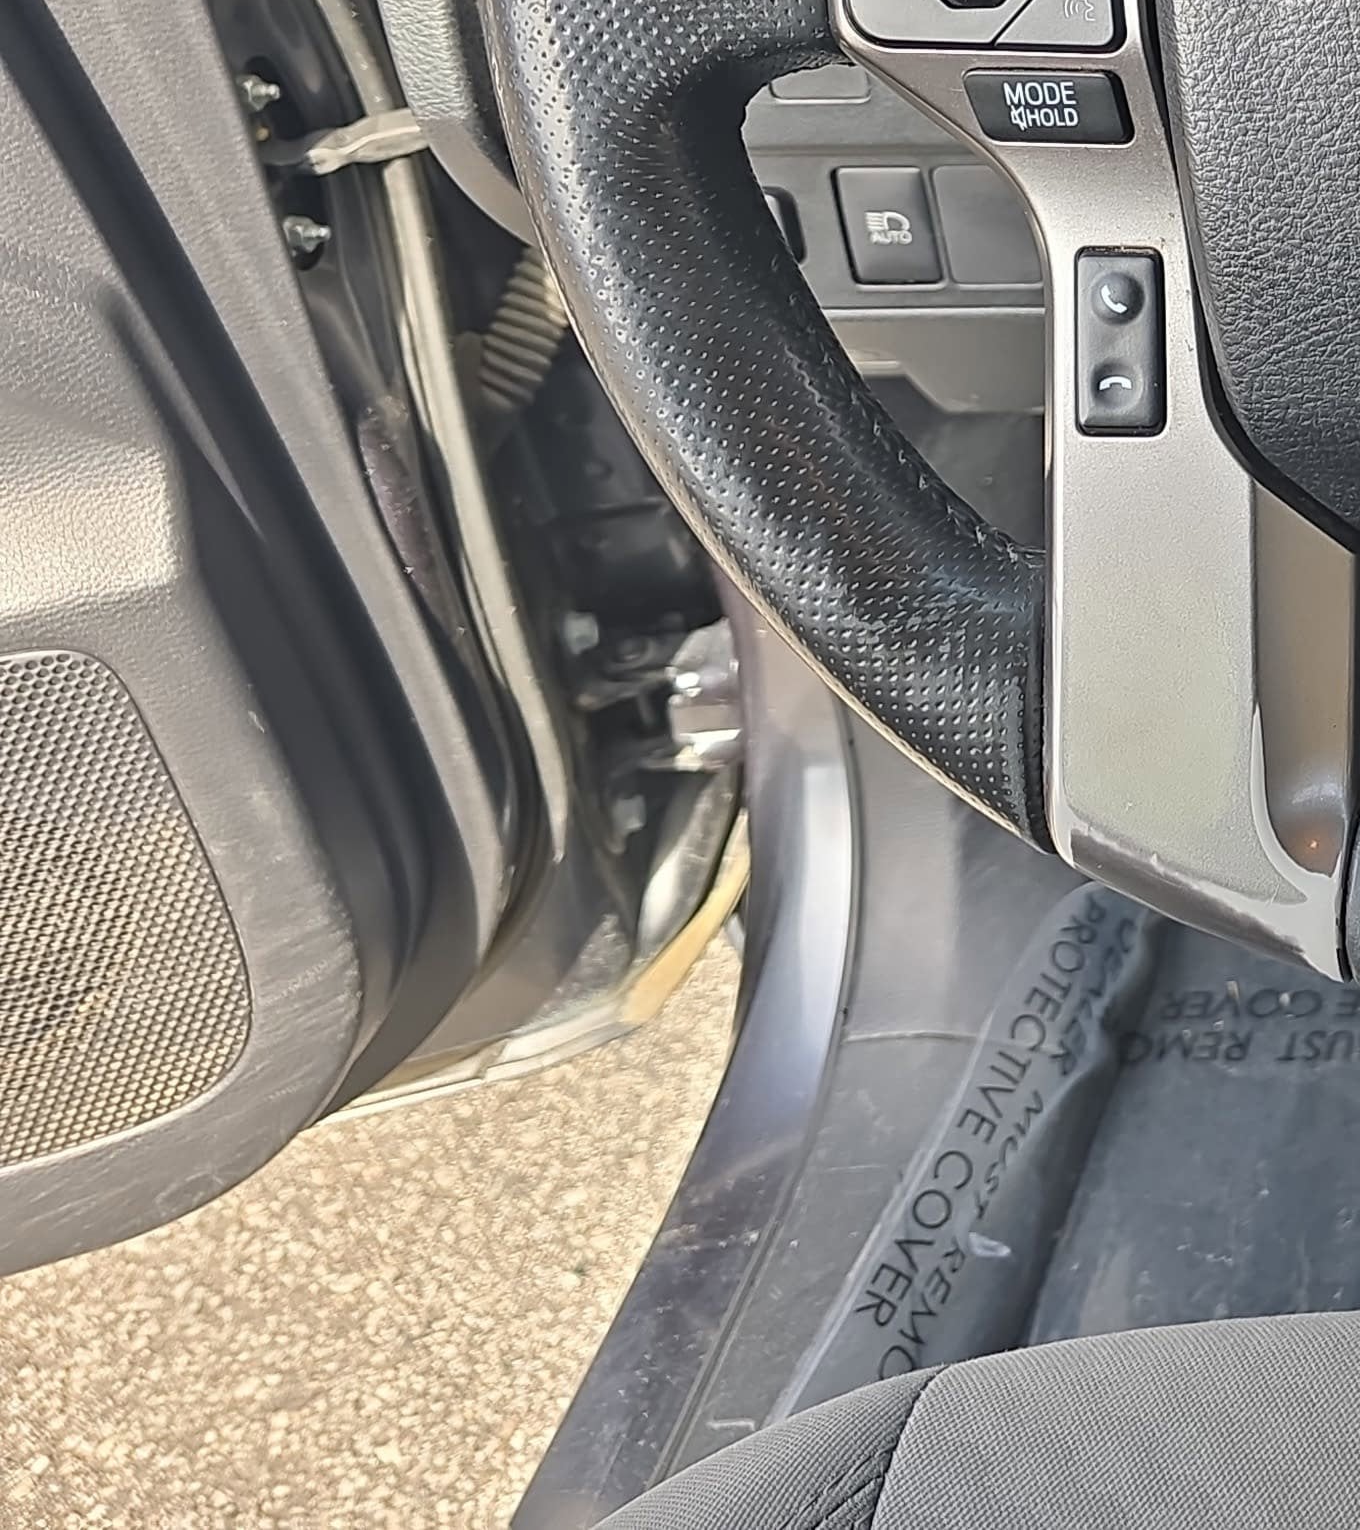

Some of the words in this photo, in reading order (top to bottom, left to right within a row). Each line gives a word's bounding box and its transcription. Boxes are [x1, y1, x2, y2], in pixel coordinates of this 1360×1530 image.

[1003, 82, 1076, 107] MODE
[1027, 107, 1078, 129] HOLD
[871, 230, 912, 245] AUTO
[957, 896, 1108, 1144] PROTECTIVE
[1163, 989, 1322, 1021] COVER
[972, 1091, 1044, 1219] MUST
[856, 1149, 974, 1328] COVER
[878, 1236, 968, 1381] REMO
